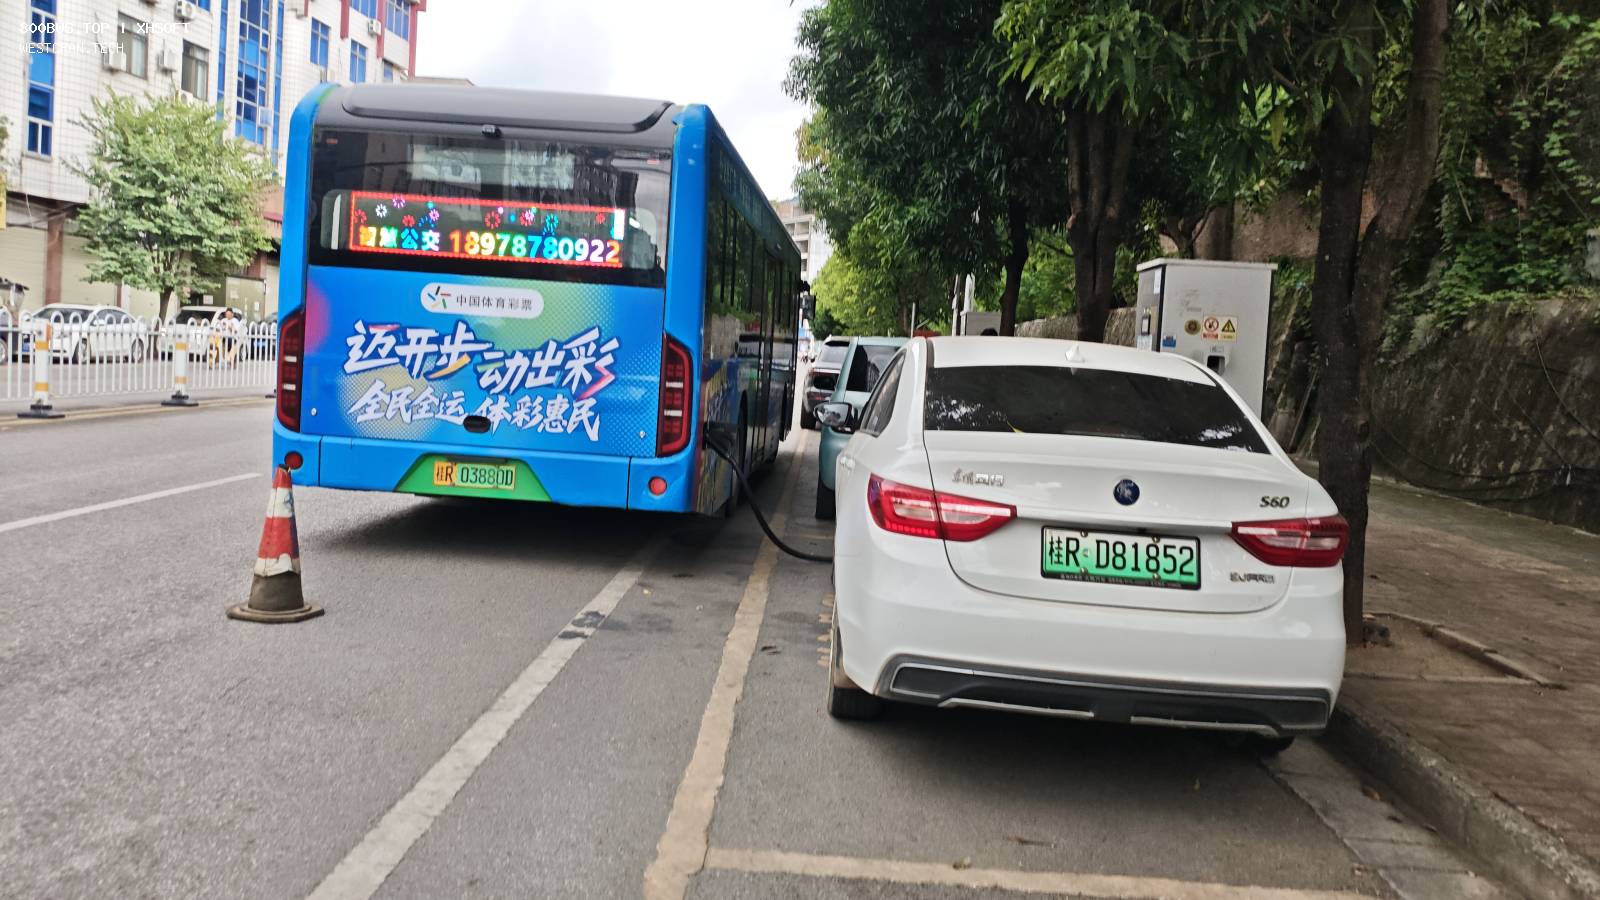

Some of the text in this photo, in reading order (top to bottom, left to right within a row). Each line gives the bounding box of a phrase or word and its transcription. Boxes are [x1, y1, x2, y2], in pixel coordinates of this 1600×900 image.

[449, 231, 621, 262] 18978780922
[456, 293, 533, 311] 中国体育彩票
[344, 319, 620, 400] 迈开步 动出彩
[348, 379, 601, 441] 全民全运 体彩惠民
[1259, 495, 1290, 509] S60
